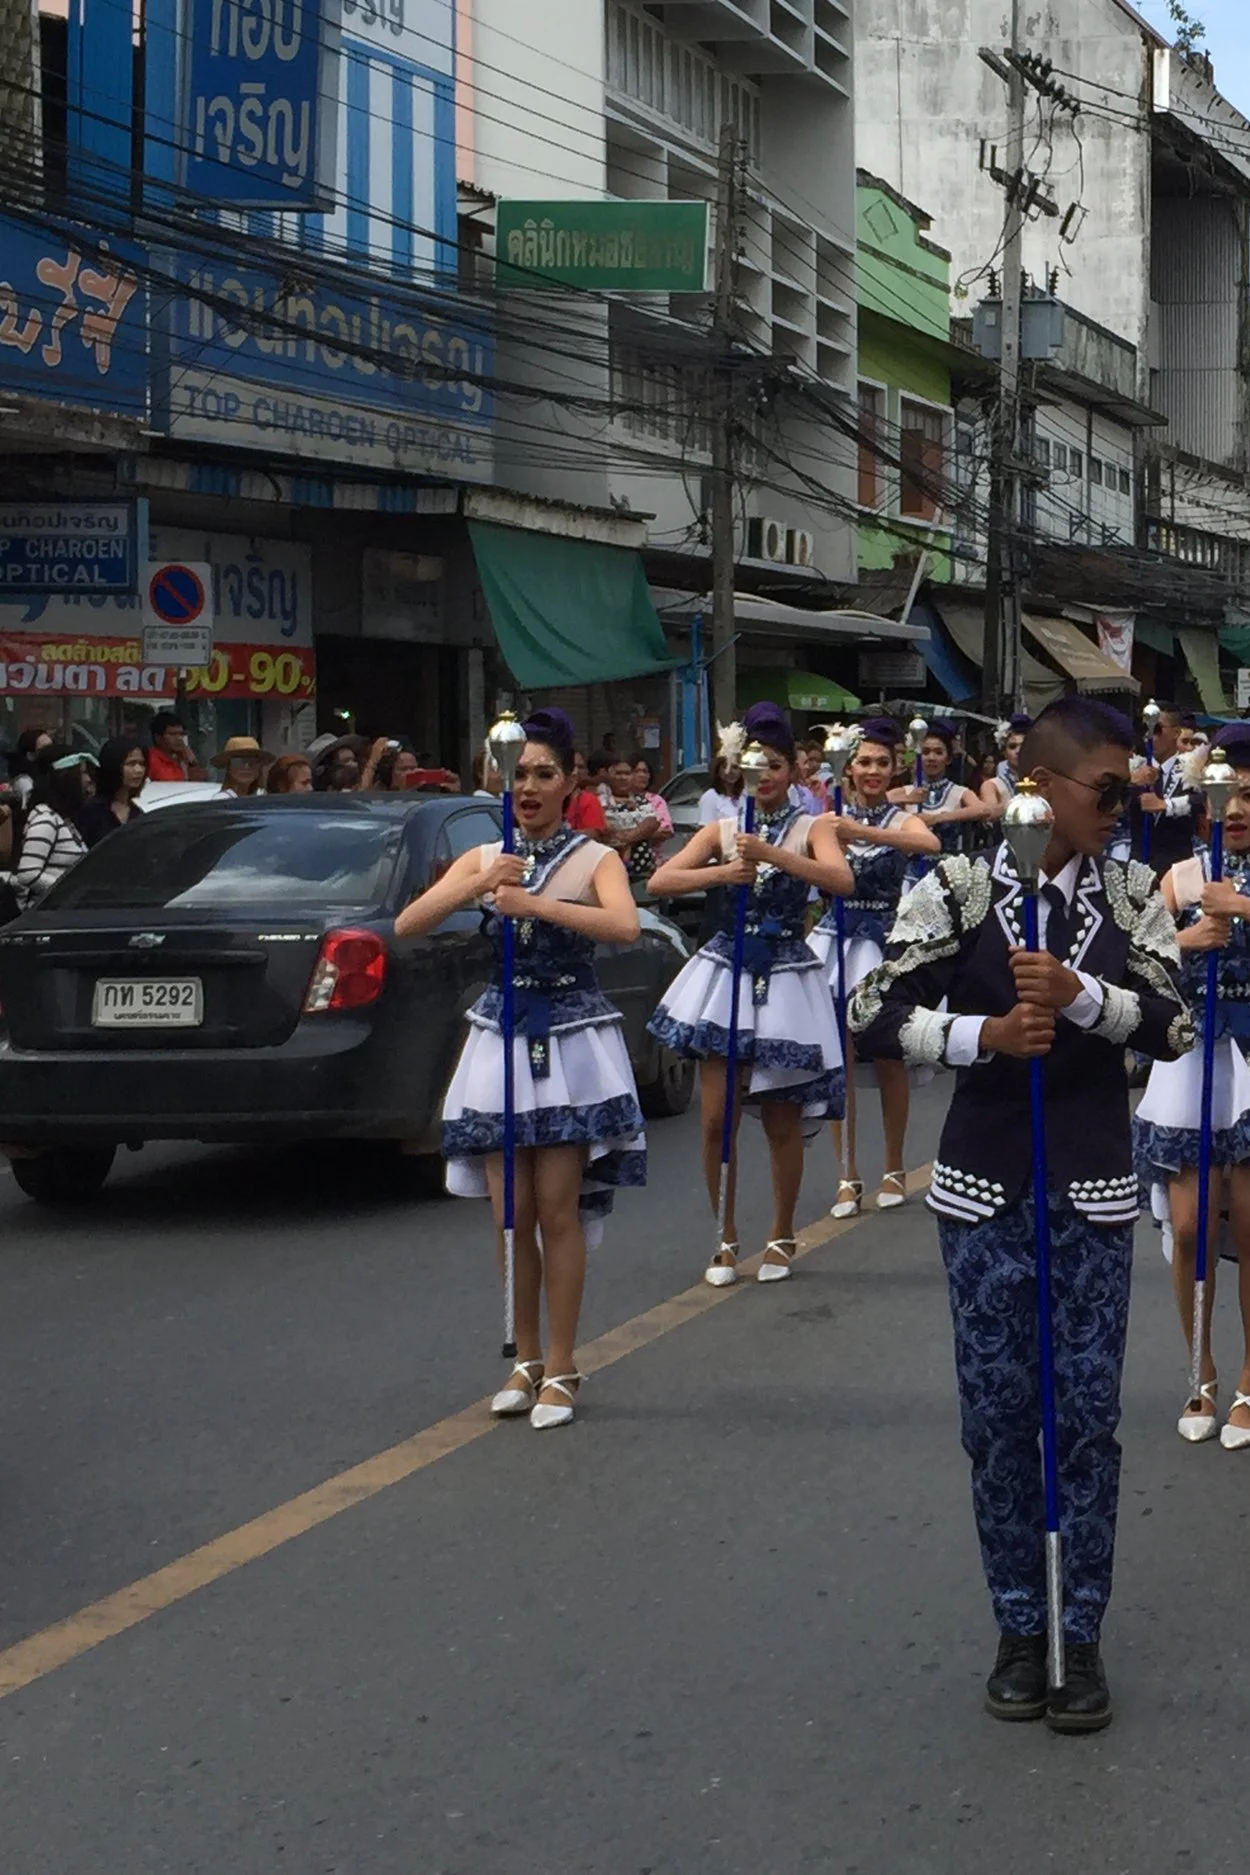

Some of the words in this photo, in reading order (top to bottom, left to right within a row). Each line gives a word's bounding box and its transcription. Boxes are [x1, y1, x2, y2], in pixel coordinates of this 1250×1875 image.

[194, 82, 310, 188] เจริญ
[188, 263, 484, 412] แว่นทอปเจริญ
[184, 384, 241, 422] TOP
[252, 397, 376, 449] CHAROEN
[386, 421, 478, 465] OPTICAL
[0, 509, 120, 532] นท็อปเจริญ
[25, 540, 124, 559] CHAROEN
[116, 665, 166, 692] ลด
[103, 985, 134, 1007] กท
[142, 985, 193, 1006] 5292
